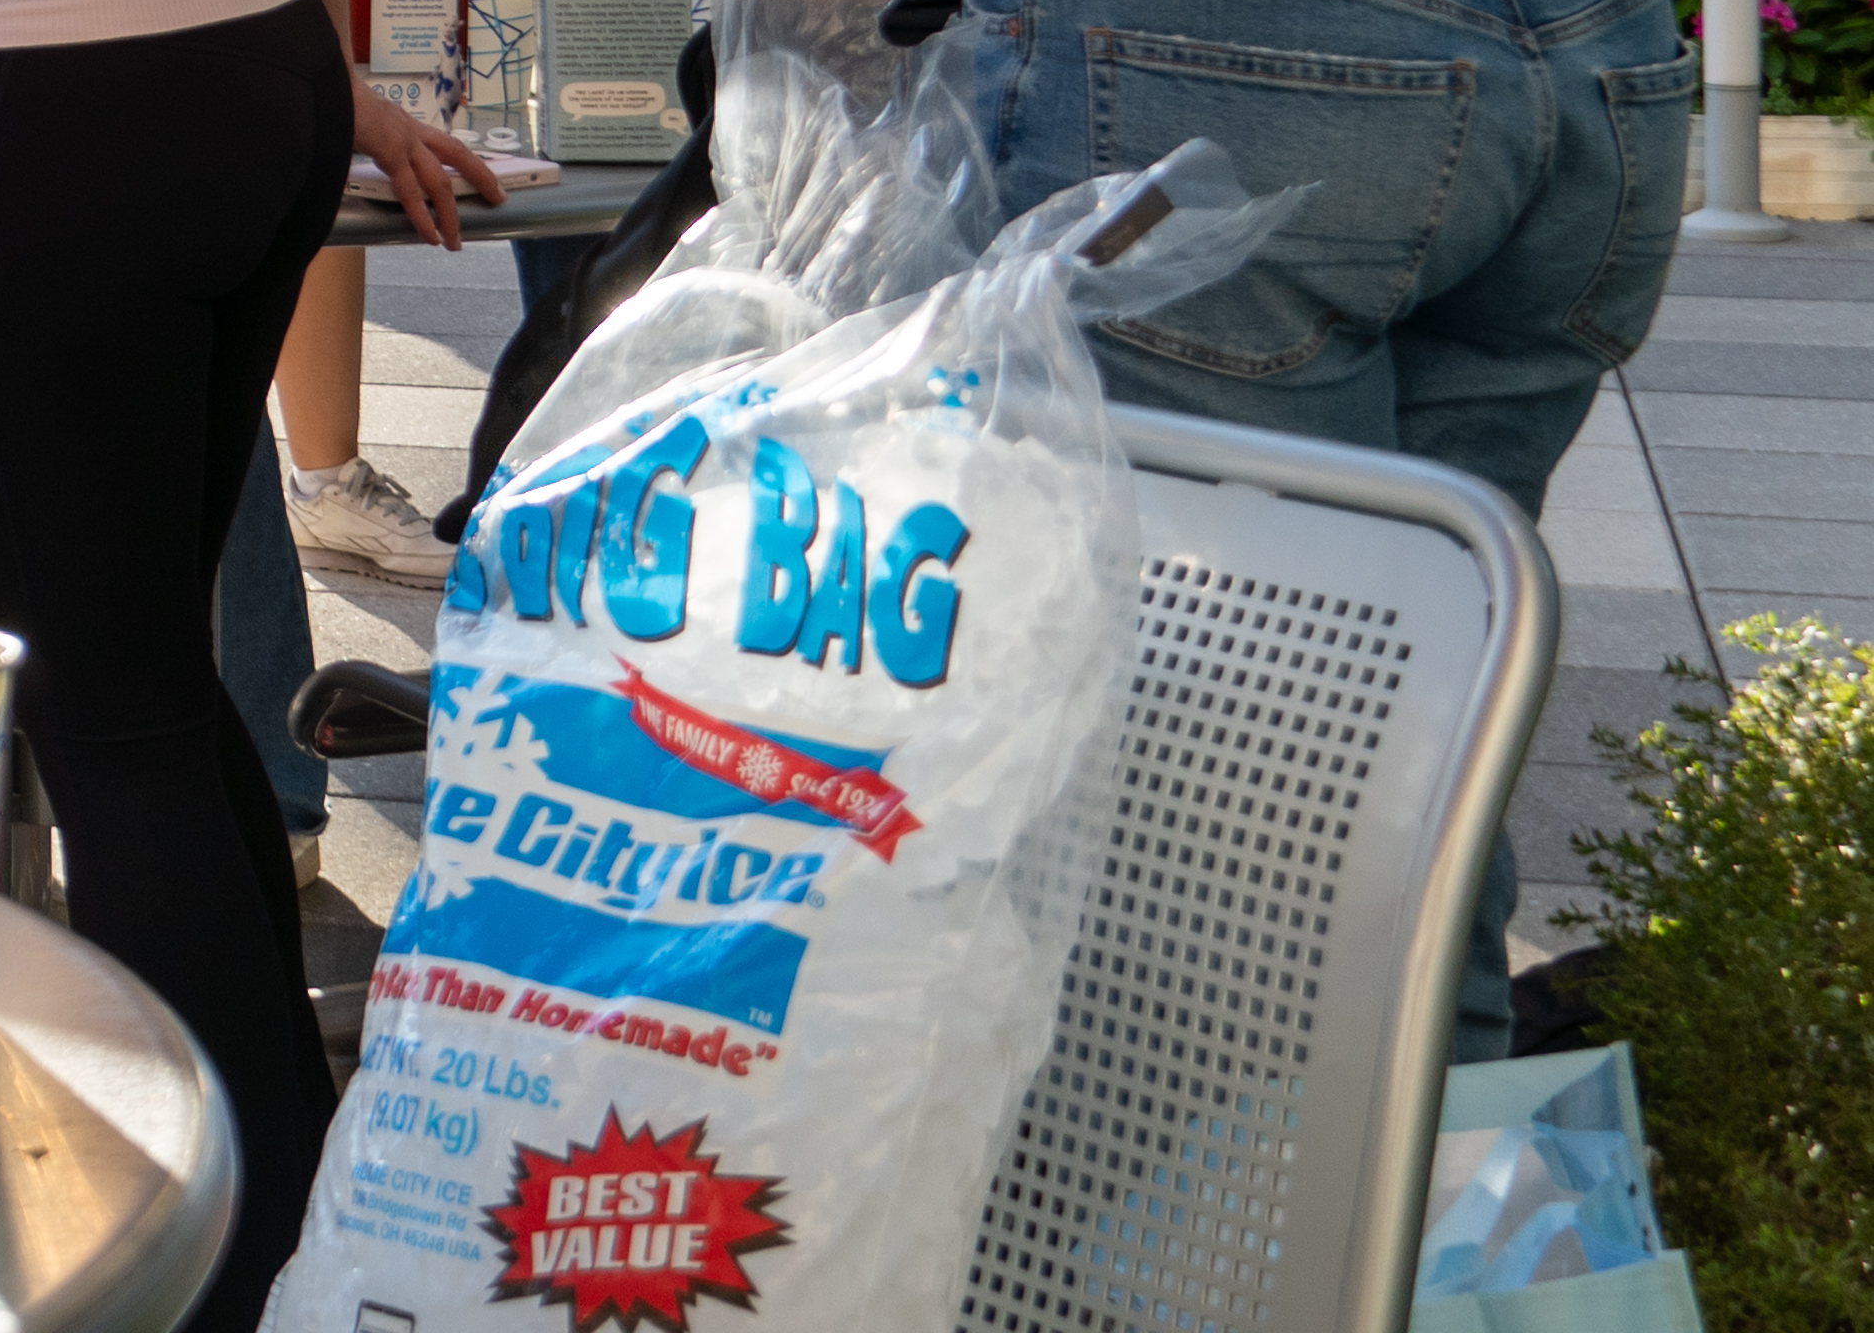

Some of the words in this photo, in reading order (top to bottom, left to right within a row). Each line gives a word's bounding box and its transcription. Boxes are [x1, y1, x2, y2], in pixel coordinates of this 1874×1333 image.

[735, 435, 971, 690] BAG
[664, 714, 737, 767] FAMILY
[421, 965, 506, 1014] Than
[430, 1046, 477, 1089] 20
[482, 1053, 561, 1110] Lbs.
[424, 1097, 480, 1158] kg)
[390, 1168, 432, 1195] CITY
[435, 1177, 473, 1206] ICE
[545, 1170, 699, 1222] BEST
[445, 1211, 468, 1232] Rd
[447, 1238, 482, 1262] USA
[530, 1222, 708, 1277] VALUE
